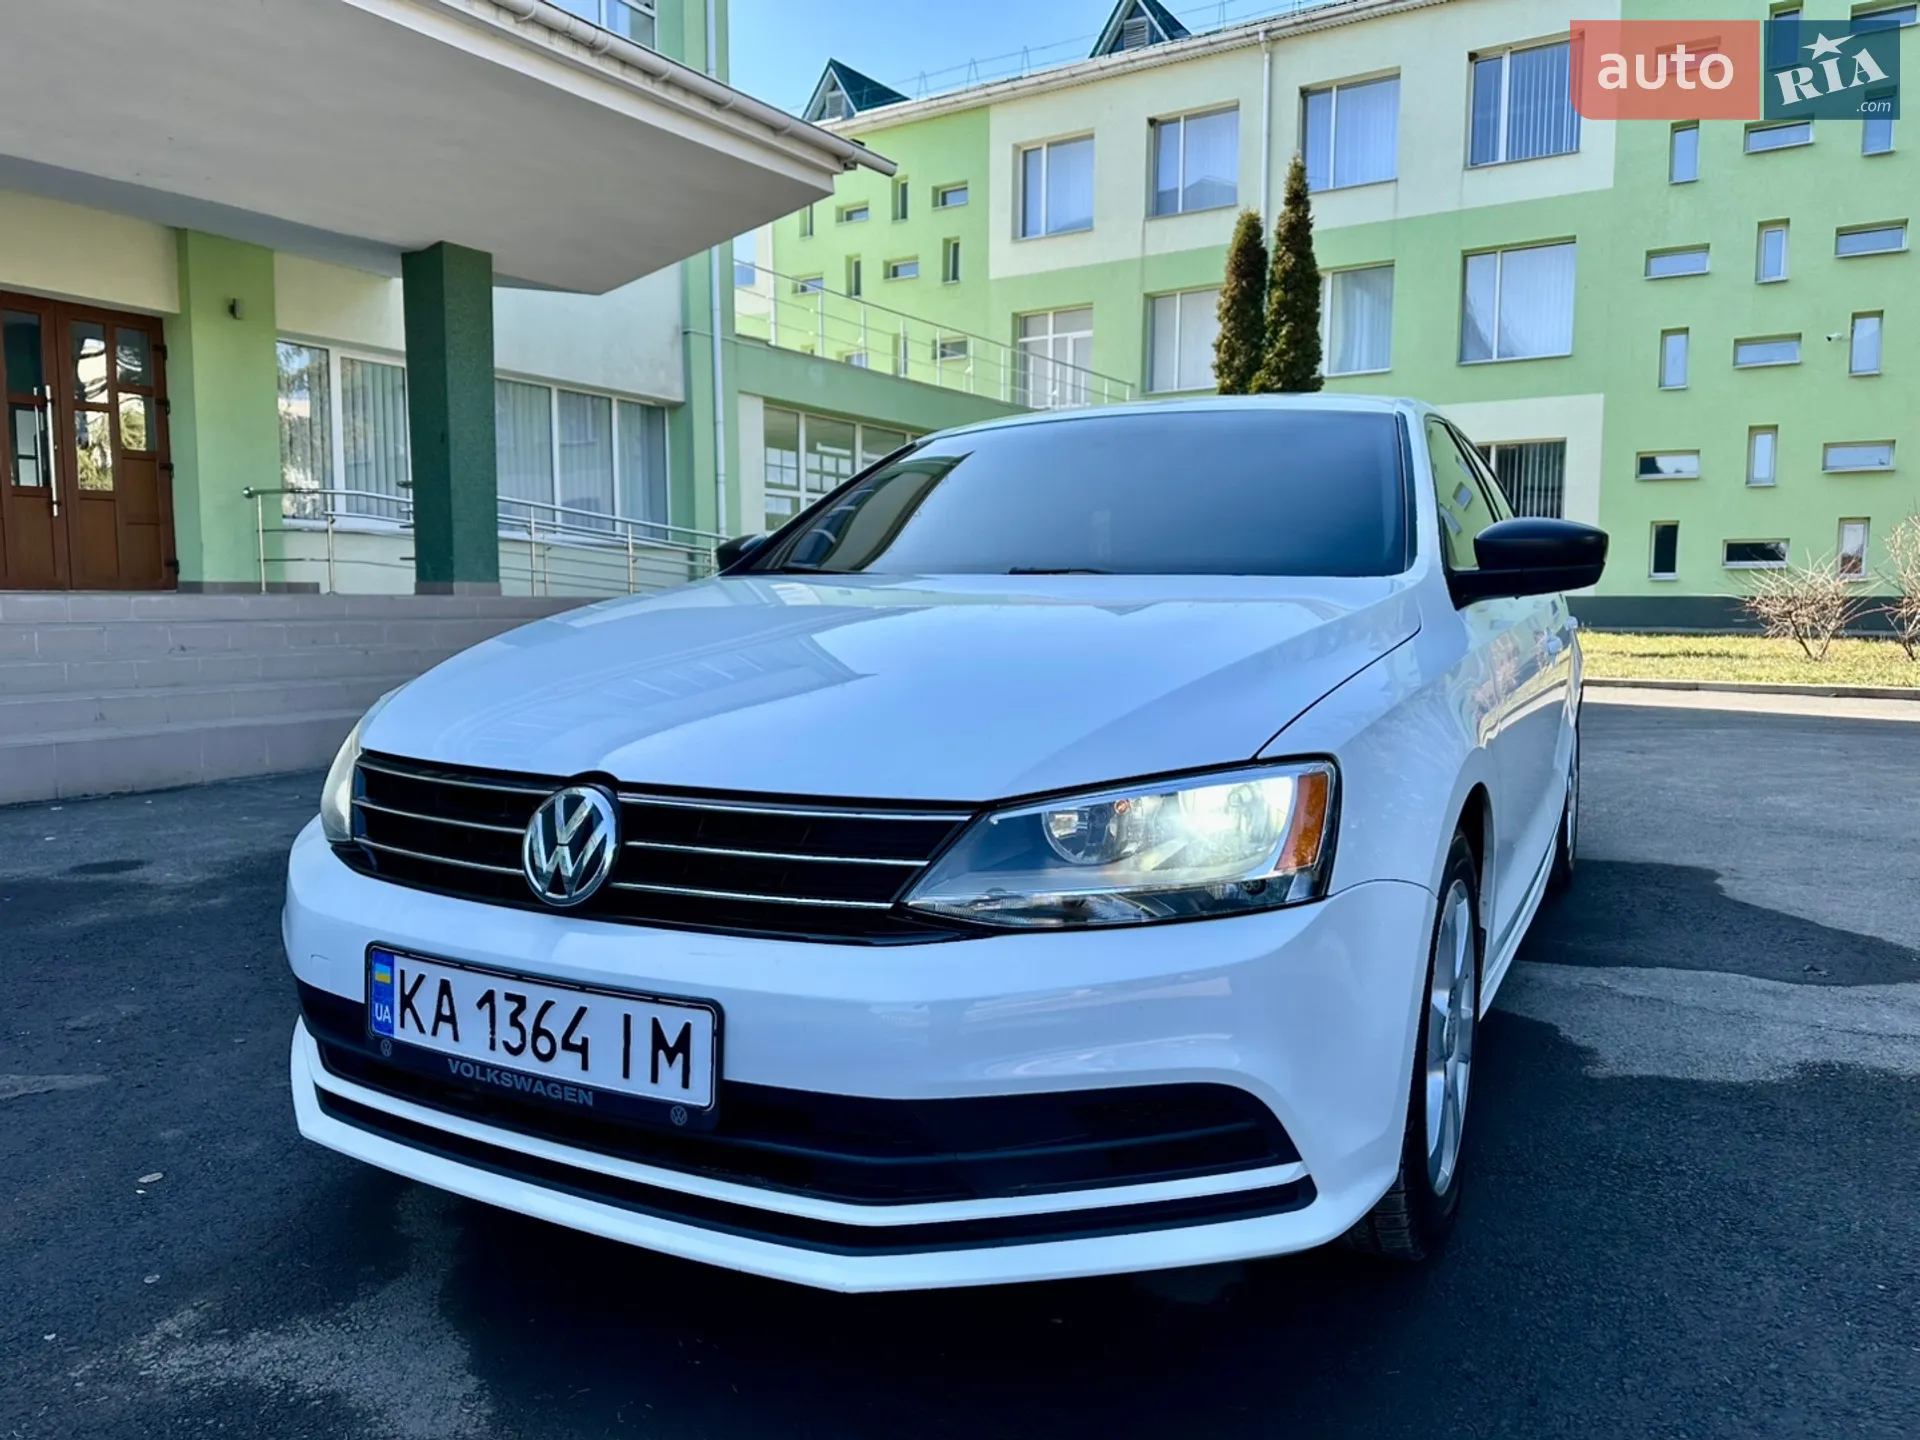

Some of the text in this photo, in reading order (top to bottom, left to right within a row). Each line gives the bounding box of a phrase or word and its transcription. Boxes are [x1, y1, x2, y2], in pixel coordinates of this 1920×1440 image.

[374, 1002, 392, 1024] UA
[399, 968, 692, 1090] KA 1364 IM
[447, 1057, 594, 1107] VOLKSWAGEN
